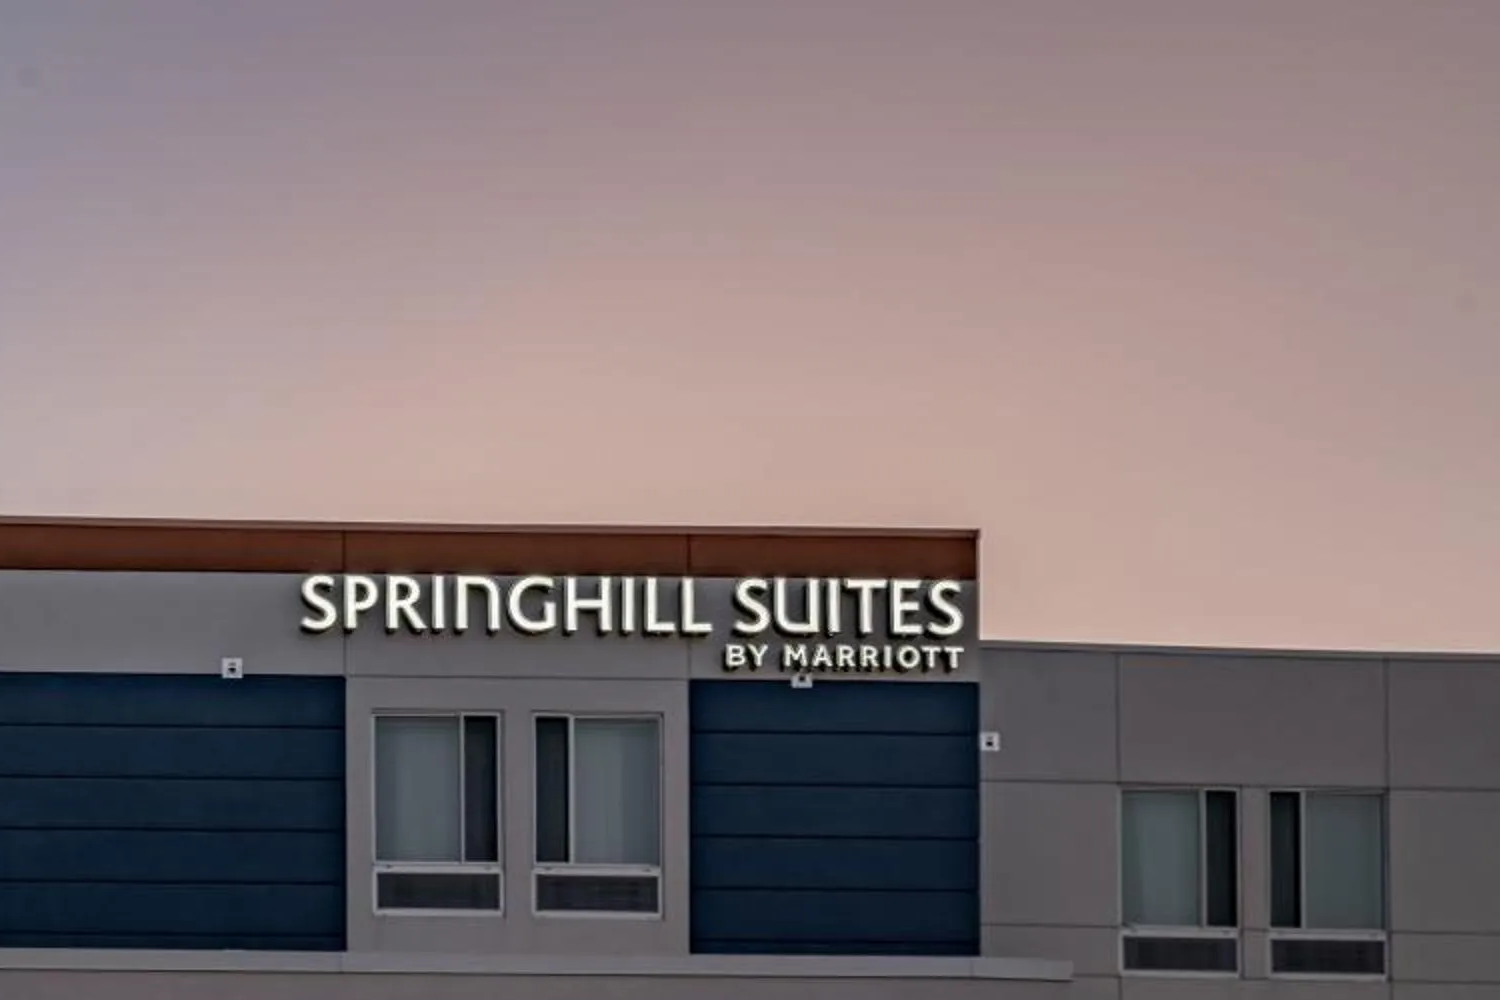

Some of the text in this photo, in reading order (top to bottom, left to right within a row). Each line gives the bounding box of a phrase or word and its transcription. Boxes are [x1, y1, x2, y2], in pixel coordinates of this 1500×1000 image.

[300, 574, 964, 636] SPRINGHILL SUITES
[725, 643, 965, 669] BY MARRIOTT
